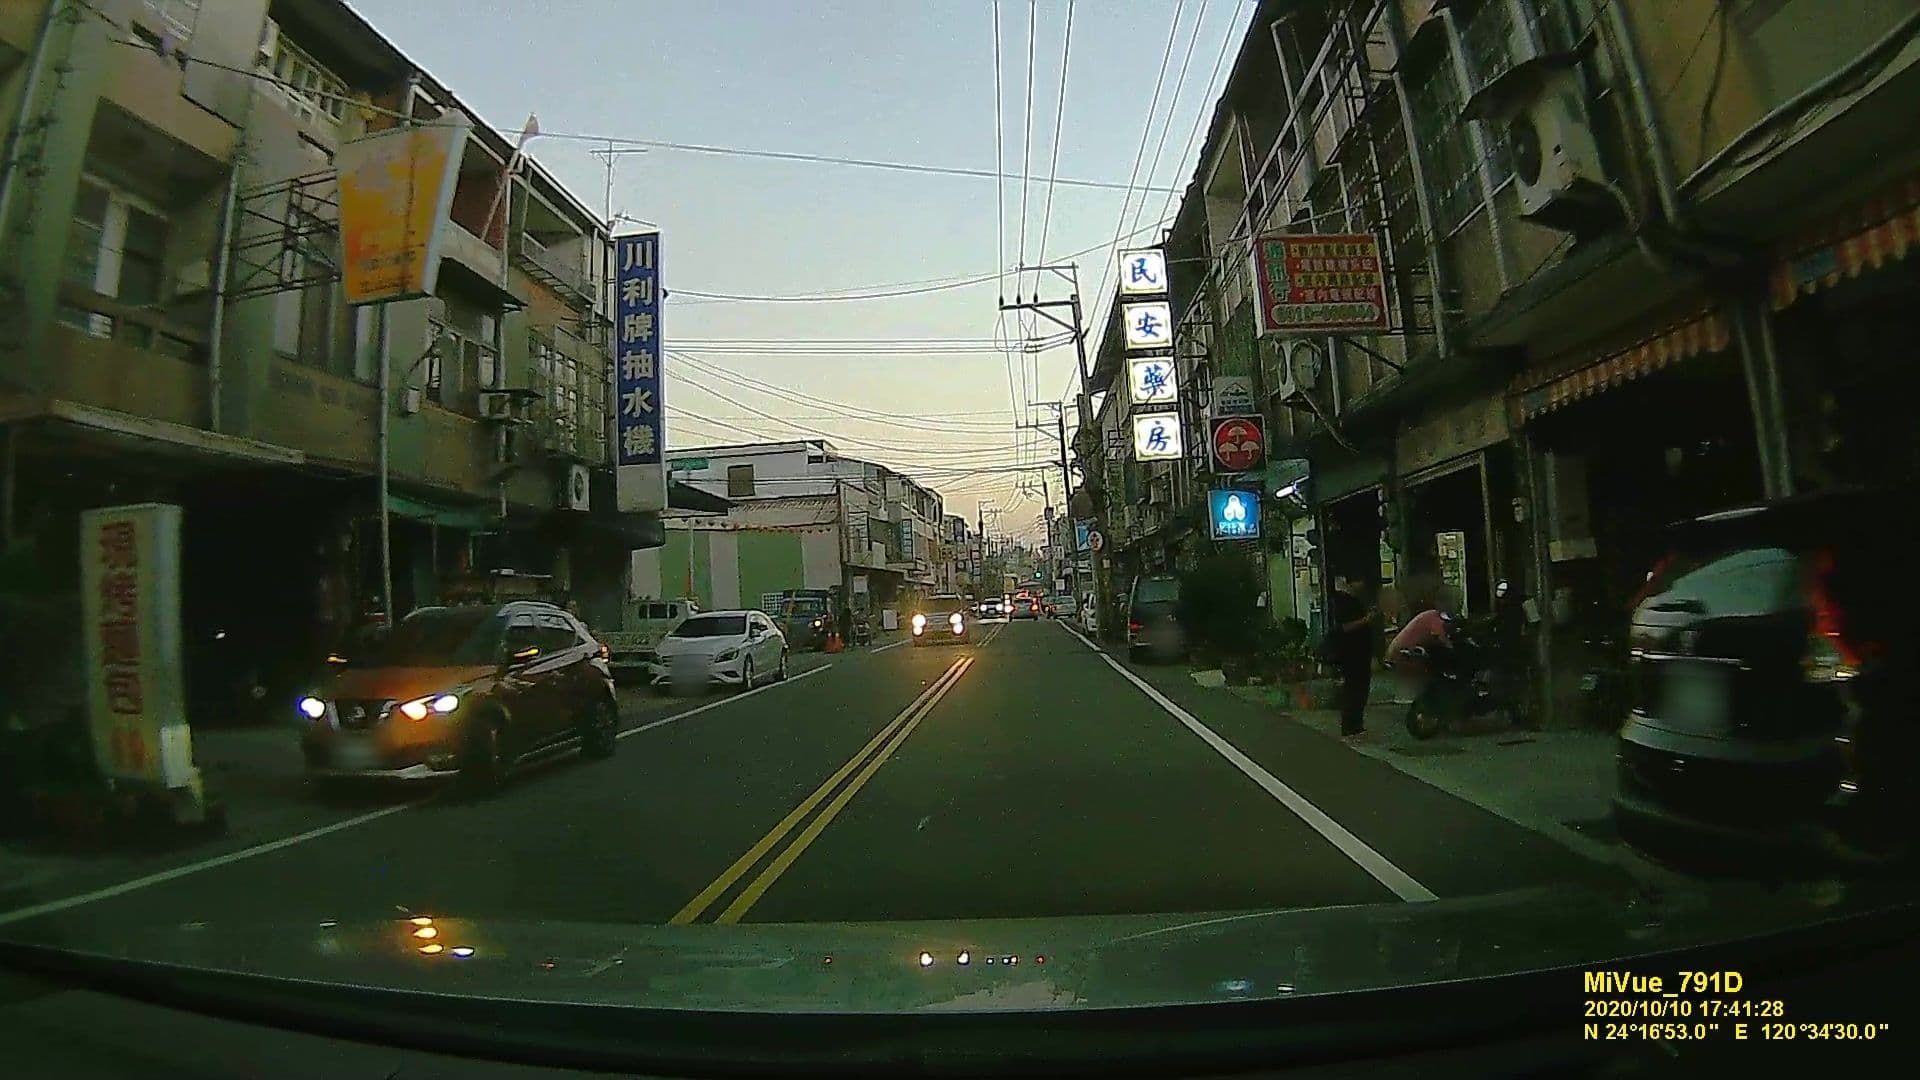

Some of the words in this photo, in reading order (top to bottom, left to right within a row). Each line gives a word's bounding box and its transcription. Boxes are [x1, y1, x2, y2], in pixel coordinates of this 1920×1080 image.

[623, 240, 654, 456] 川利牌抽水機
[1131, 258, 1171, 451] 民安藥房
